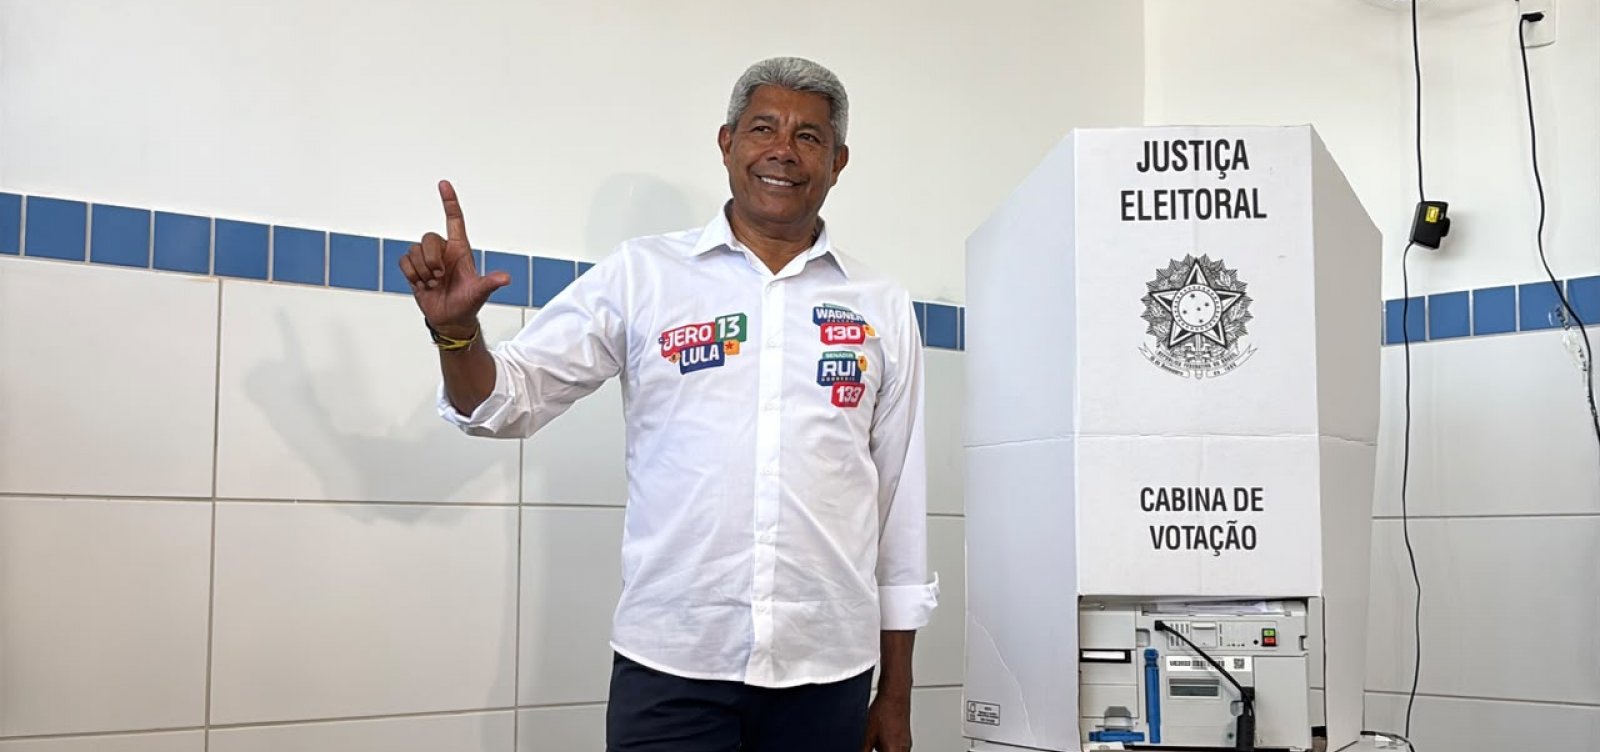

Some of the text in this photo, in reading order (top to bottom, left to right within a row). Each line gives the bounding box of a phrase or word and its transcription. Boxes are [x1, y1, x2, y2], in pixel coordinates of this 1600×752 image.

[1136, 139, 1250, 180] JUSTIÇA
[1121, 188, 1267, 221] ELEITORAL
[815, 308, 864, 322] WAGNER
[663, 316, 741, 352] JERO 13
[825, 325, 861, 341] 130
[681, 344, 720, 367] LULA
[821, 361, 856, 377] RUI
[836, 386, 862, 403] 133
[1140, 487, 1264, 512] CABINA DE
[1149, 520, 1257, 557] VOTAÇÃO
